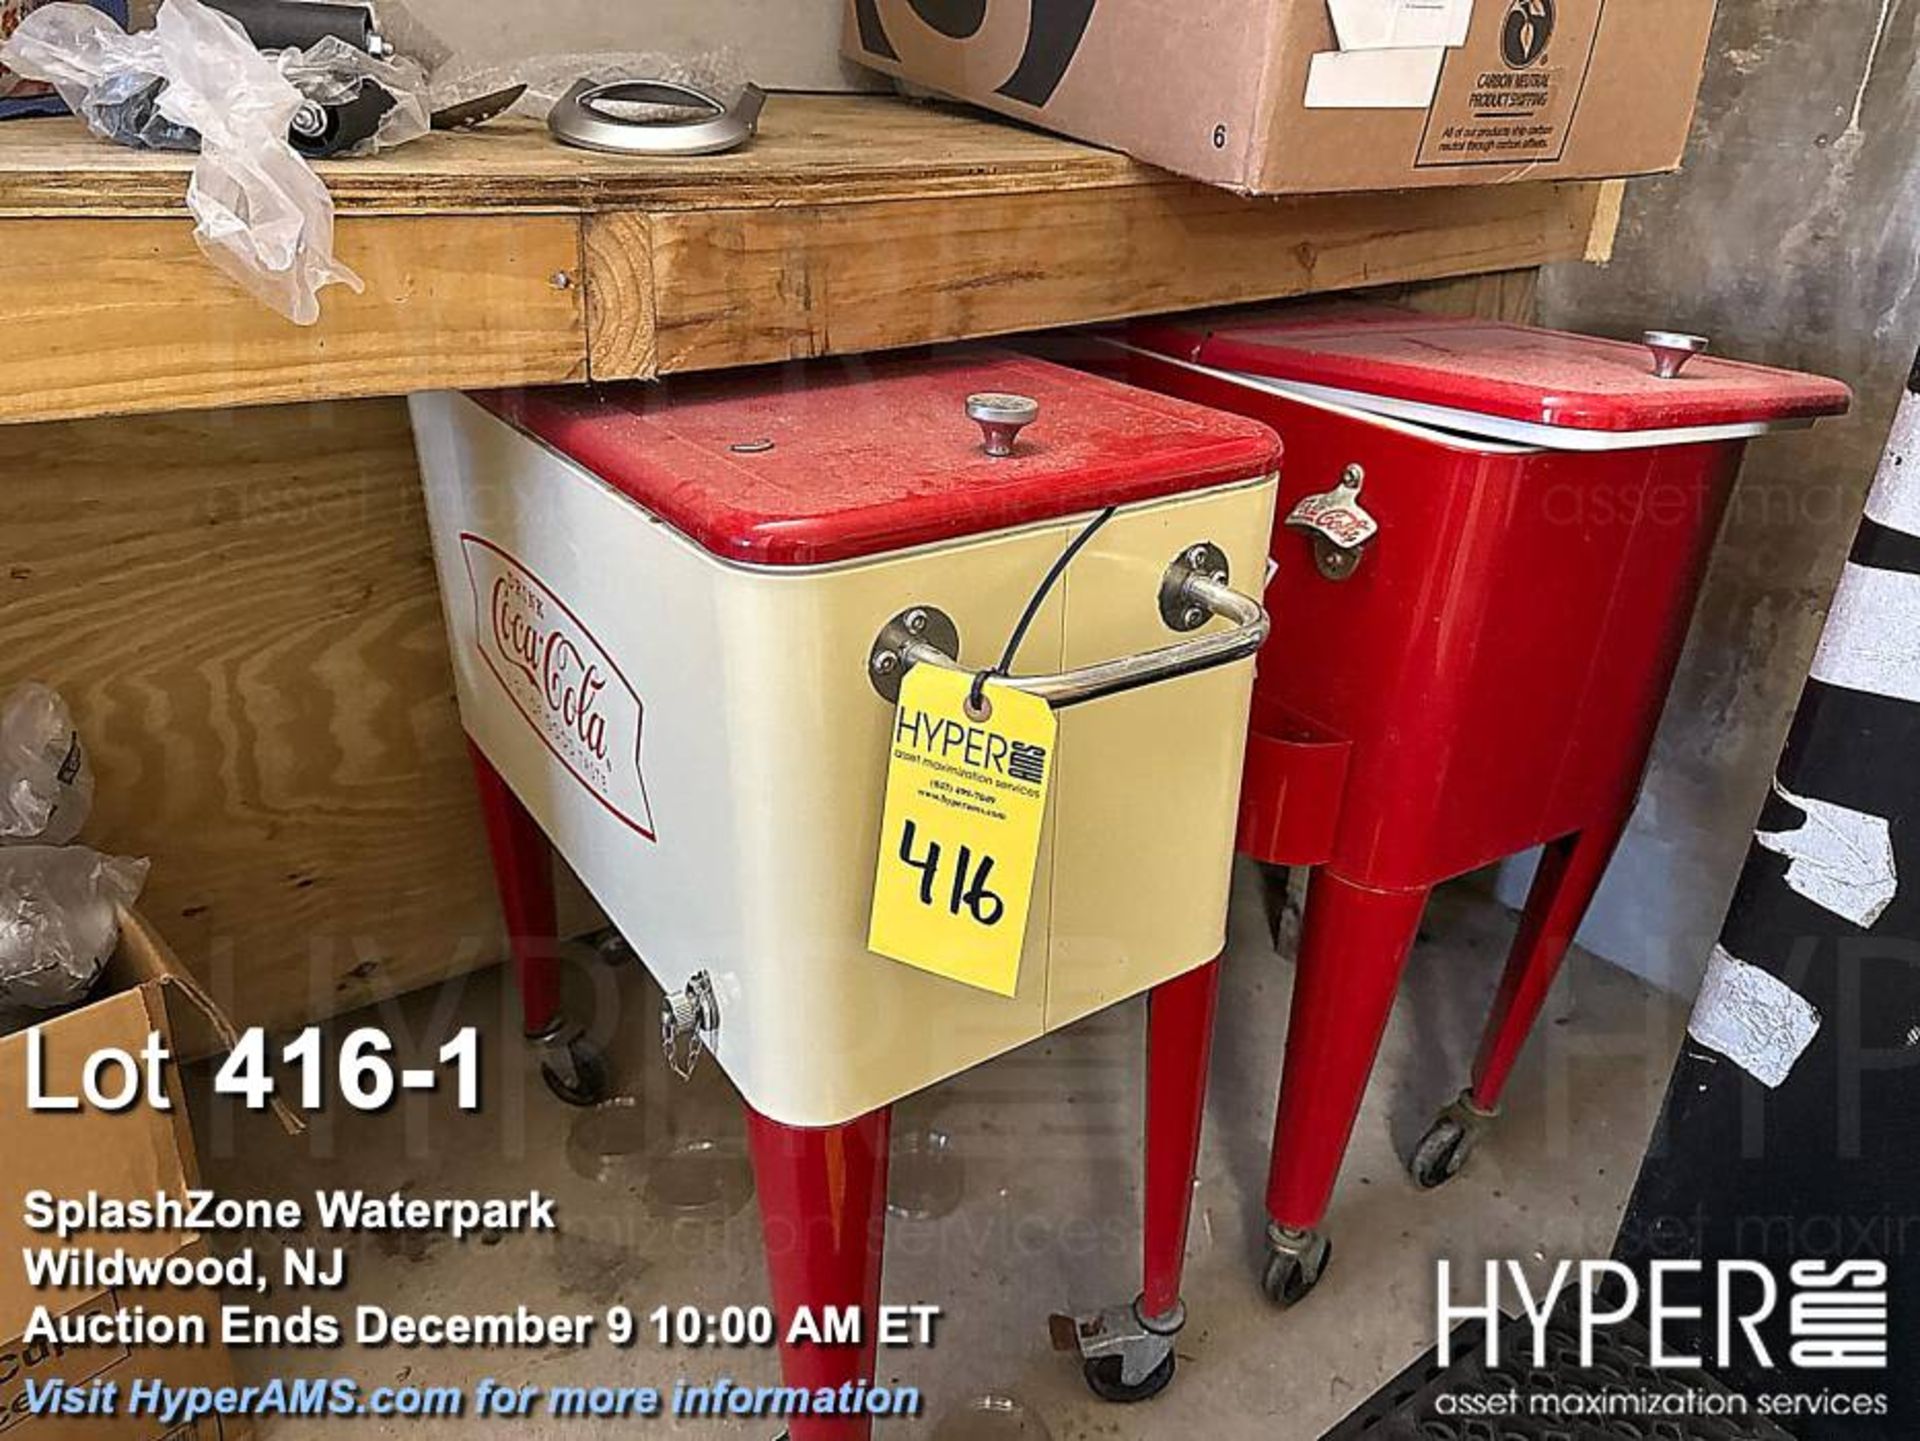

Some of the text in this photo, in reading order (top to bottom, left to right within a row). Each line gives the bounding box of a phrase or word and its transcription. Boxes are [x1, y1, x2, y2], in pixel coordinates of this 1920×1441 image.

[1468, 91, 1509, 107] PRODUCT
[1476, 74, 1550, 89] CARBON NEUTRAL
[1212, 123, 1226, 149] 6
[896, 705, 1009, 774] HYPER
[894, 748, 1041, 799] asset maximization services
[898, 818, 1005, 927] 416
